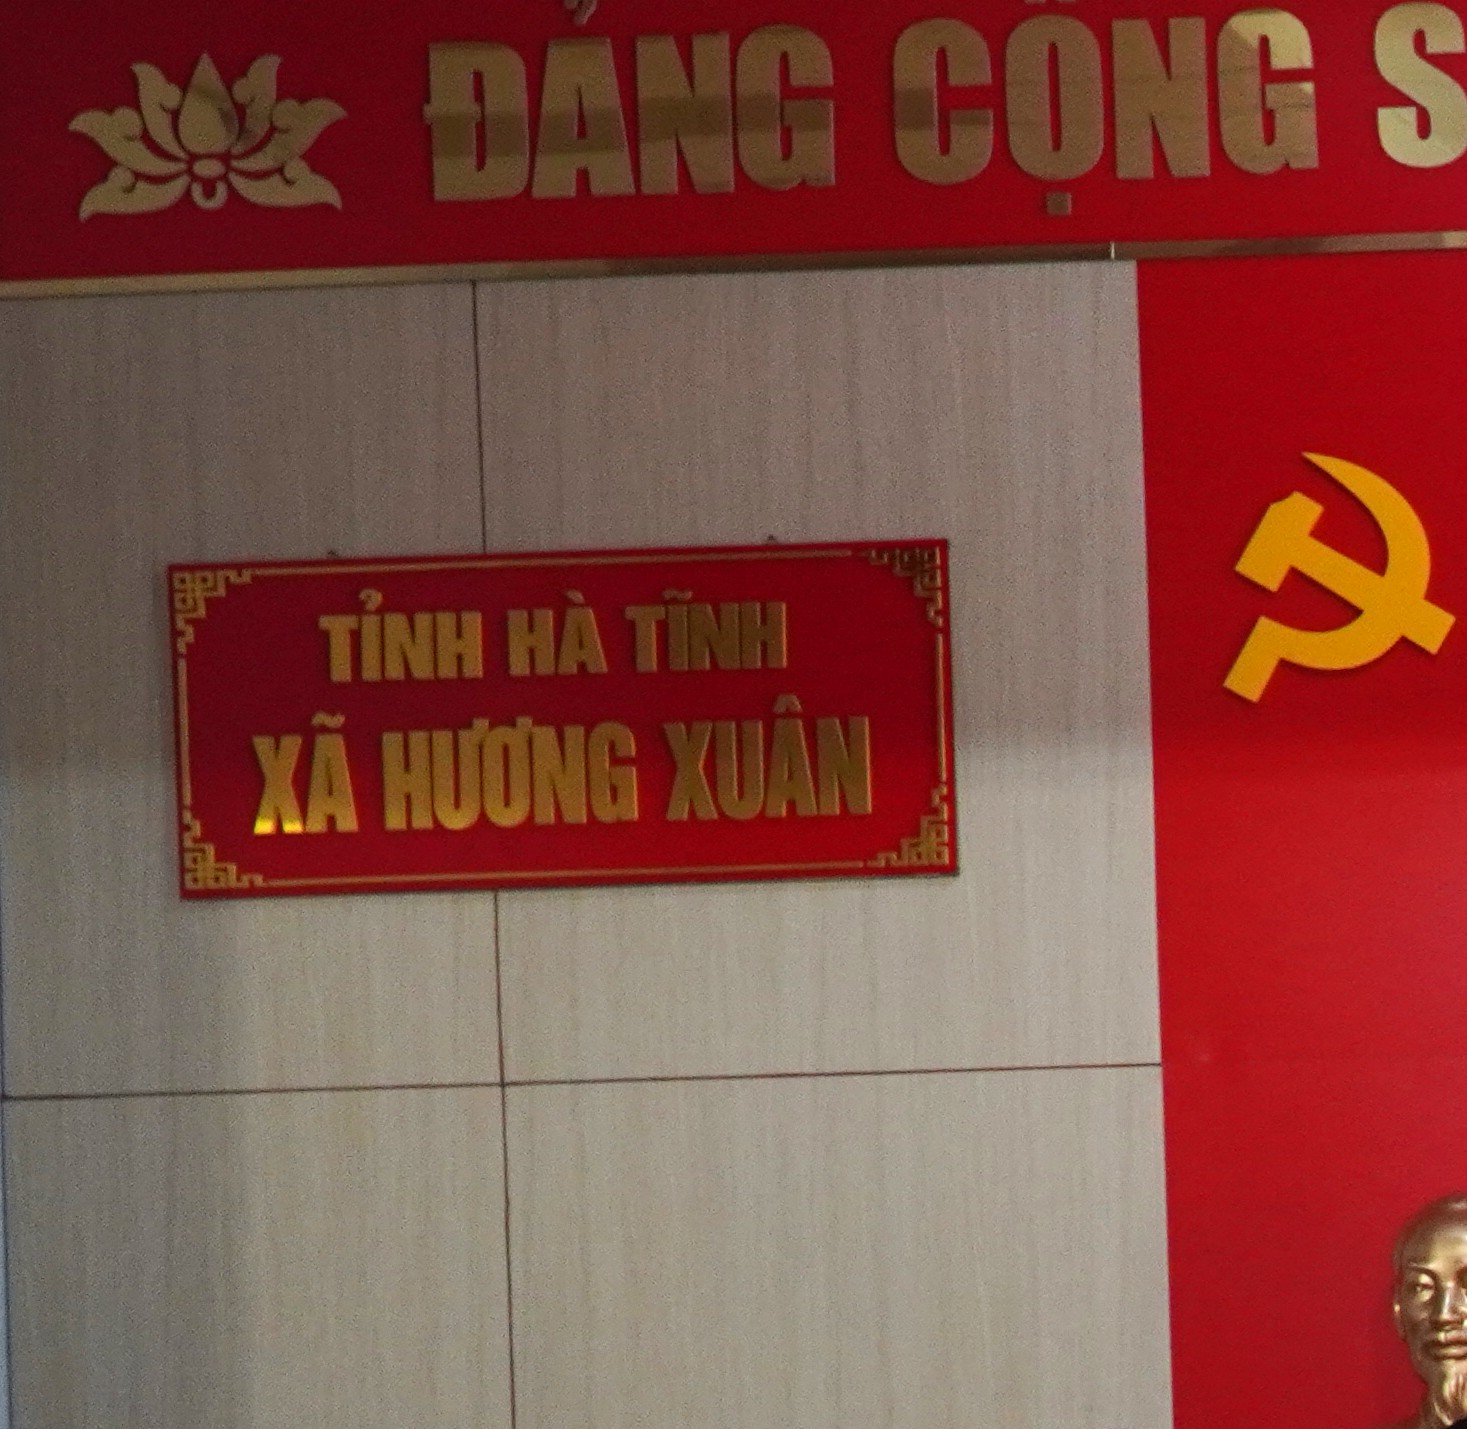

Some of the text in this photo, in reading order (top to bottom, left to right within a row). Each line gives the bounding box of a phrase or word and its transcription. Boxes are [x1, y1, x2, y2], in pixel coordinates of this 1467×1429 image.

[318, 588, 788, 683] TỈNH HÀ TĨNH
[252, 694, 872, 836] XÃ HƯƠNG XUÂN
